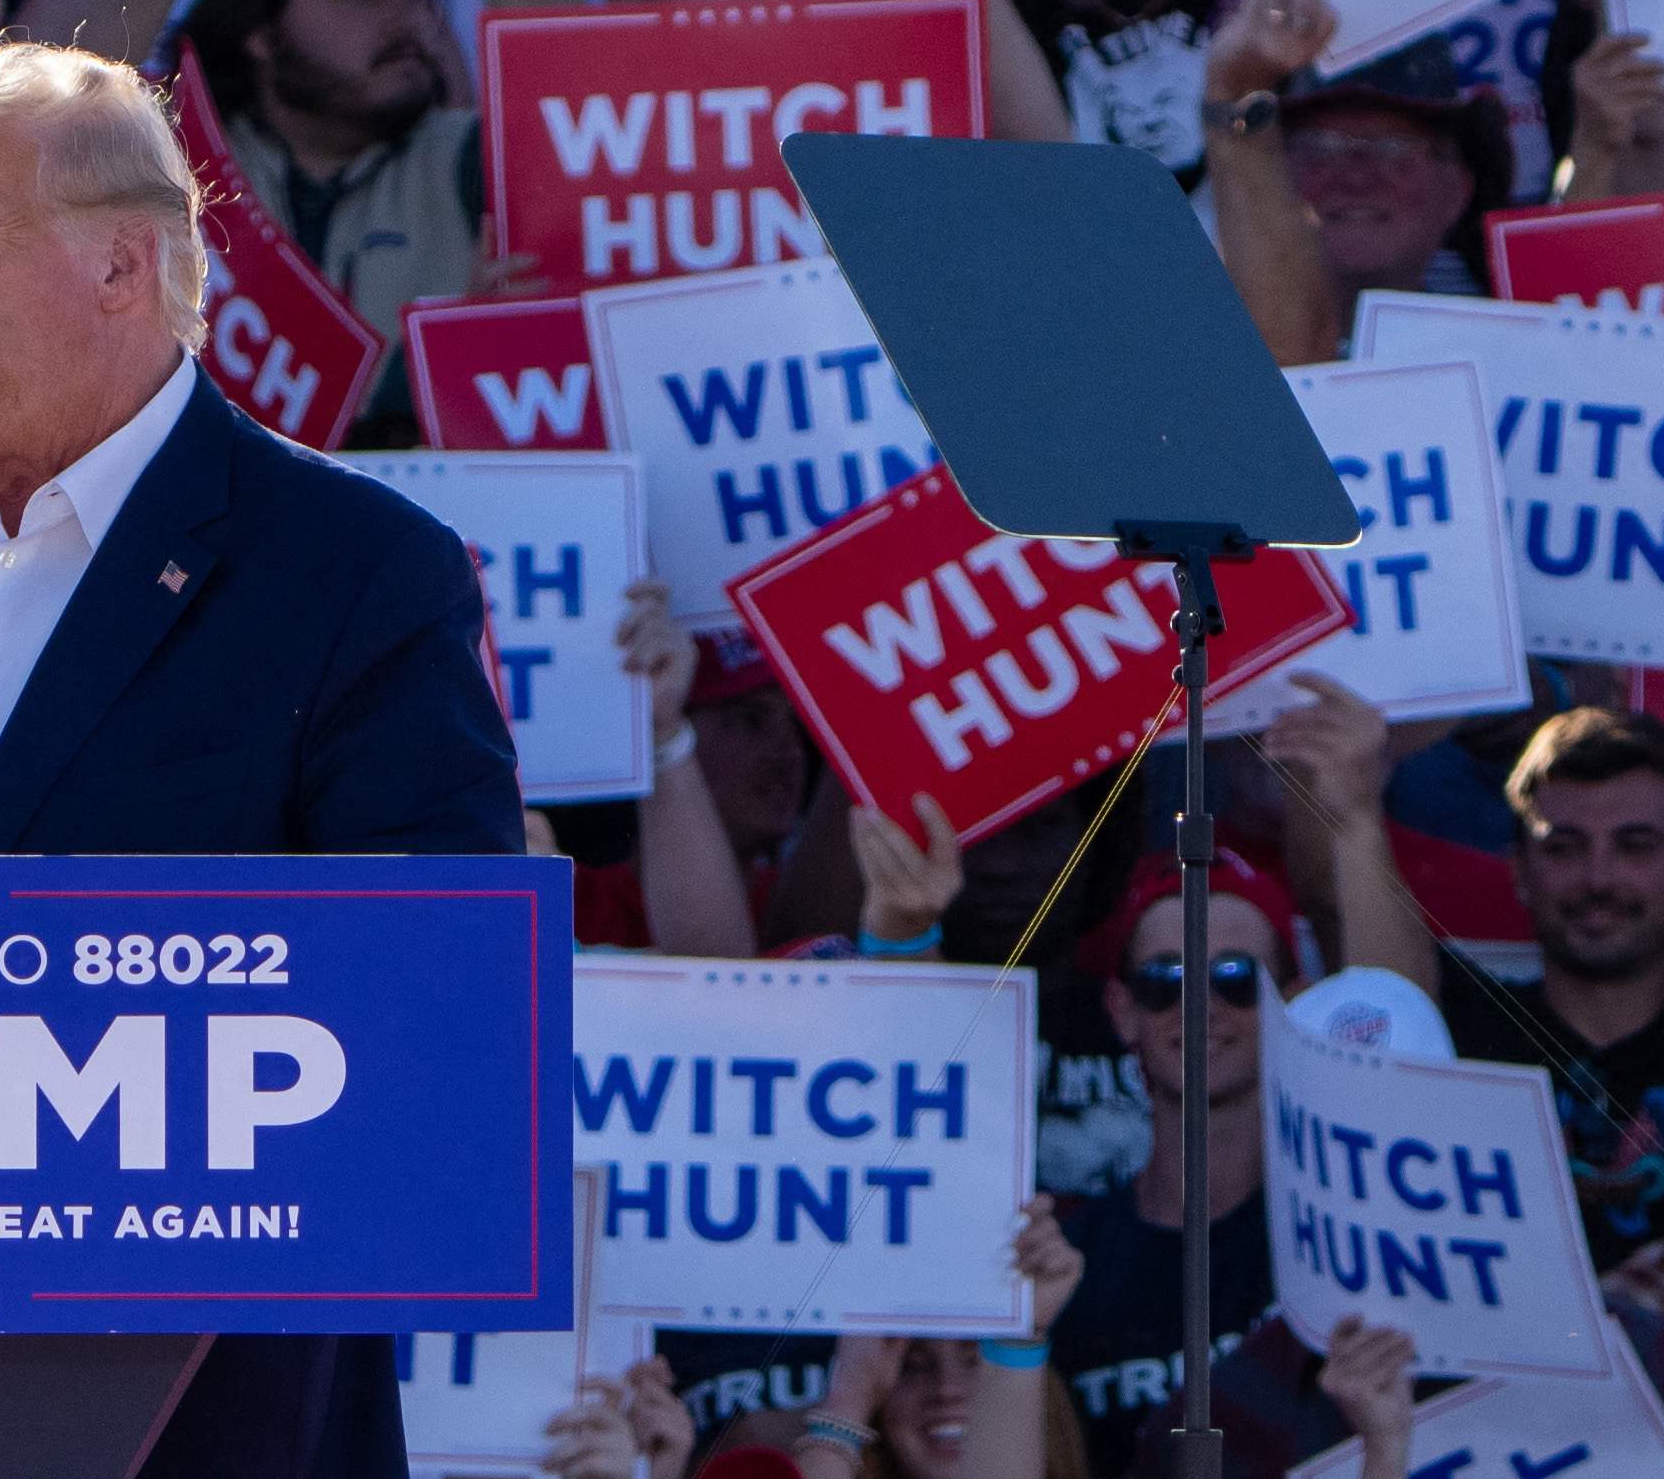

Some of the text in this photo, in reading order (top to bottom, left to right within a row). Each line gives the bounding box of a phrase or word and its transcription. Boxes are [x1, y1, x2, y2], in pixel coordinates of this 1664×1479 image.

[540, 80, 930, 177] WITCH
[580, 190, 834, 275] HUN
[662, 344, 914, 447] WIT
[716, 442, 939, 544] HU
[824, 527, 1124, 692] WIT
[73, 934, 289, 986] 88022
[576, 1056, 965, 1140] WITCH
[604, 1162, 930, 1244] HUNT
[1279, 1105, 1522, 1220] WITCH
[114, 1205, 300, 1240] AGAIN!
[1291, 1190, 1509, 1307] HUNT
[687, 1365, 830, 1432] TRU
